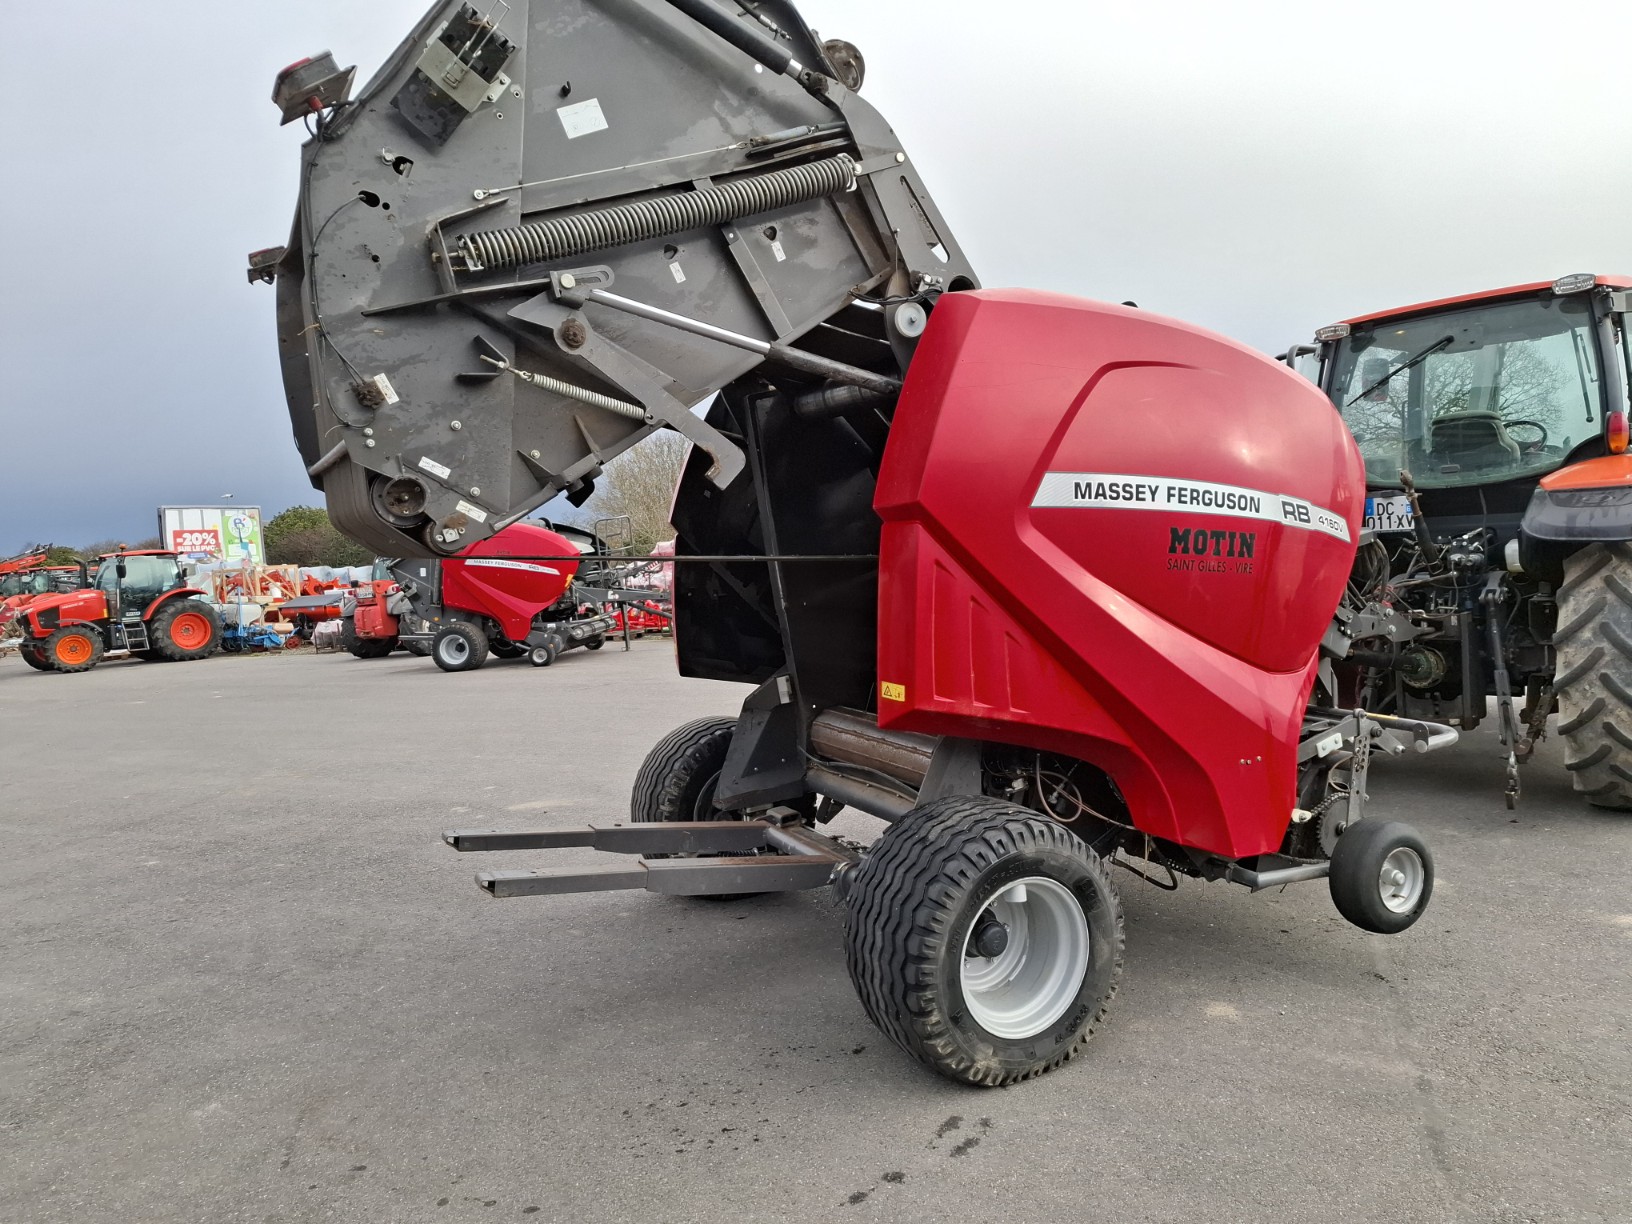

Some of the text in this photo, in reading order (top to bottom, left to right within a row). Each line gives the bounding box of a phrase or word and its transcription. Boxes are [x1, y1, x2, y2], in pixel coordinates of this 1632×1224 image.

[1073, 481, 1260, 514] MASSEY FERGUSON
[1376, 501, 1394, 516] DC
[1281, 500, 1344, 533] RB 4160V
[176, 532, 216, 546] -20%
[1168, 526, 1256, 559] MOTIN
[1167, 558, 1195, 572] SAINT
[1197, 560, 1226, 573] GILLES
[1235, 562, 1254, 574] VIRE
